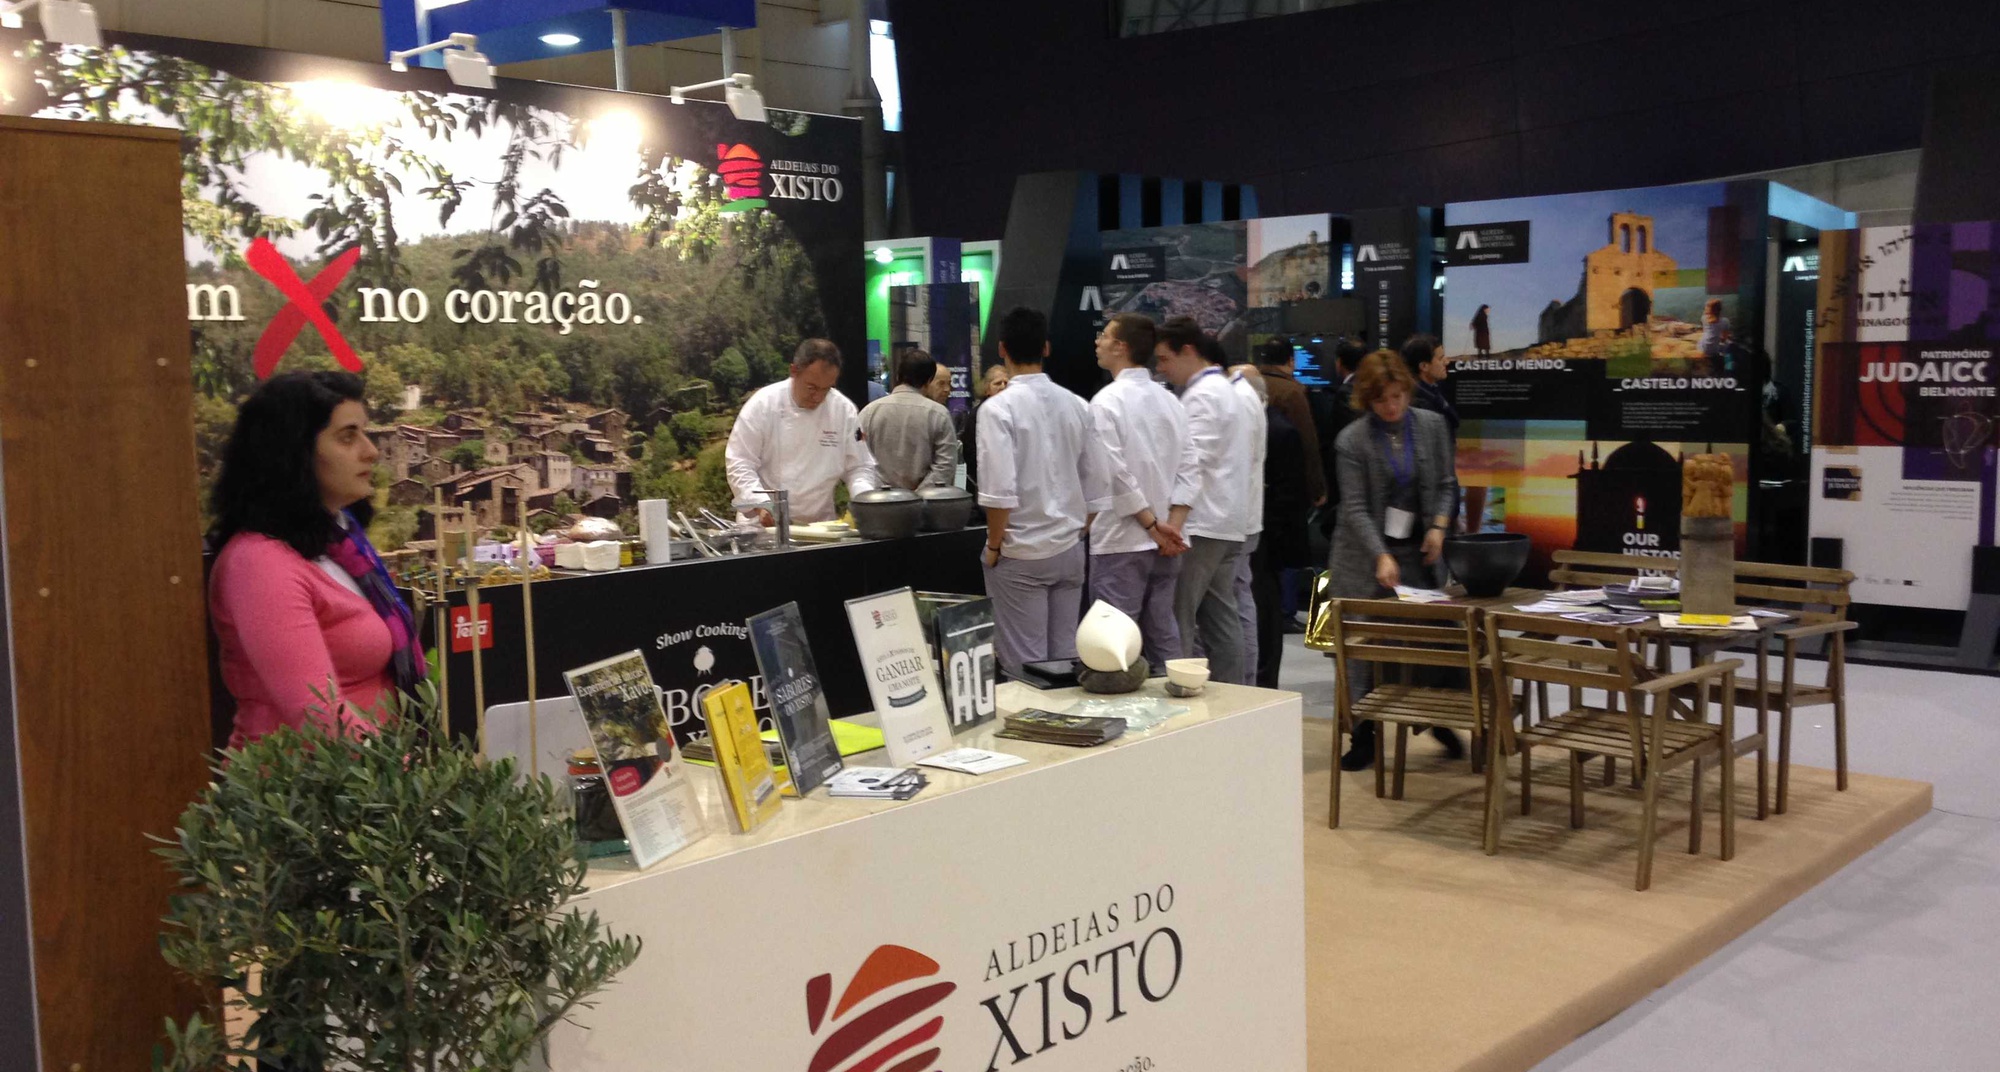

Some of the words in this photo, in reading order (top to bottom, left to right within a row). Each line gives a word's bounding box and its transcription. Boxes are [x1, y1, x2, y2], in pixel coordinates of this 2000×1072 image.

[770, 160, 817, 173] ALDEIAS
[821, 164, 839, 175] DO
[769, 173, 843, 202] XISTO
[359, 286, 429, 323] no
[444, 279, 643, 335] coração.
[1920, 348, 1992, 359] PATRIMÓNIO
[1919, 386, 1997, 397] BELMONTE
[1623, 532, 1660, 547] OUR
[454, 616, 488, 639] Tea
[656, 629, 693, 650] Show
[695, 622, 748, 640] Cooking
[876, 656, 924, 683] GANHAR
[775, 674, 813, 704] SABORES
[983, 902, 1121, 982] ALDEIAS
[1133, 883, 1176, 923] DO
[979, 926, 1184, 1072] XISTO
